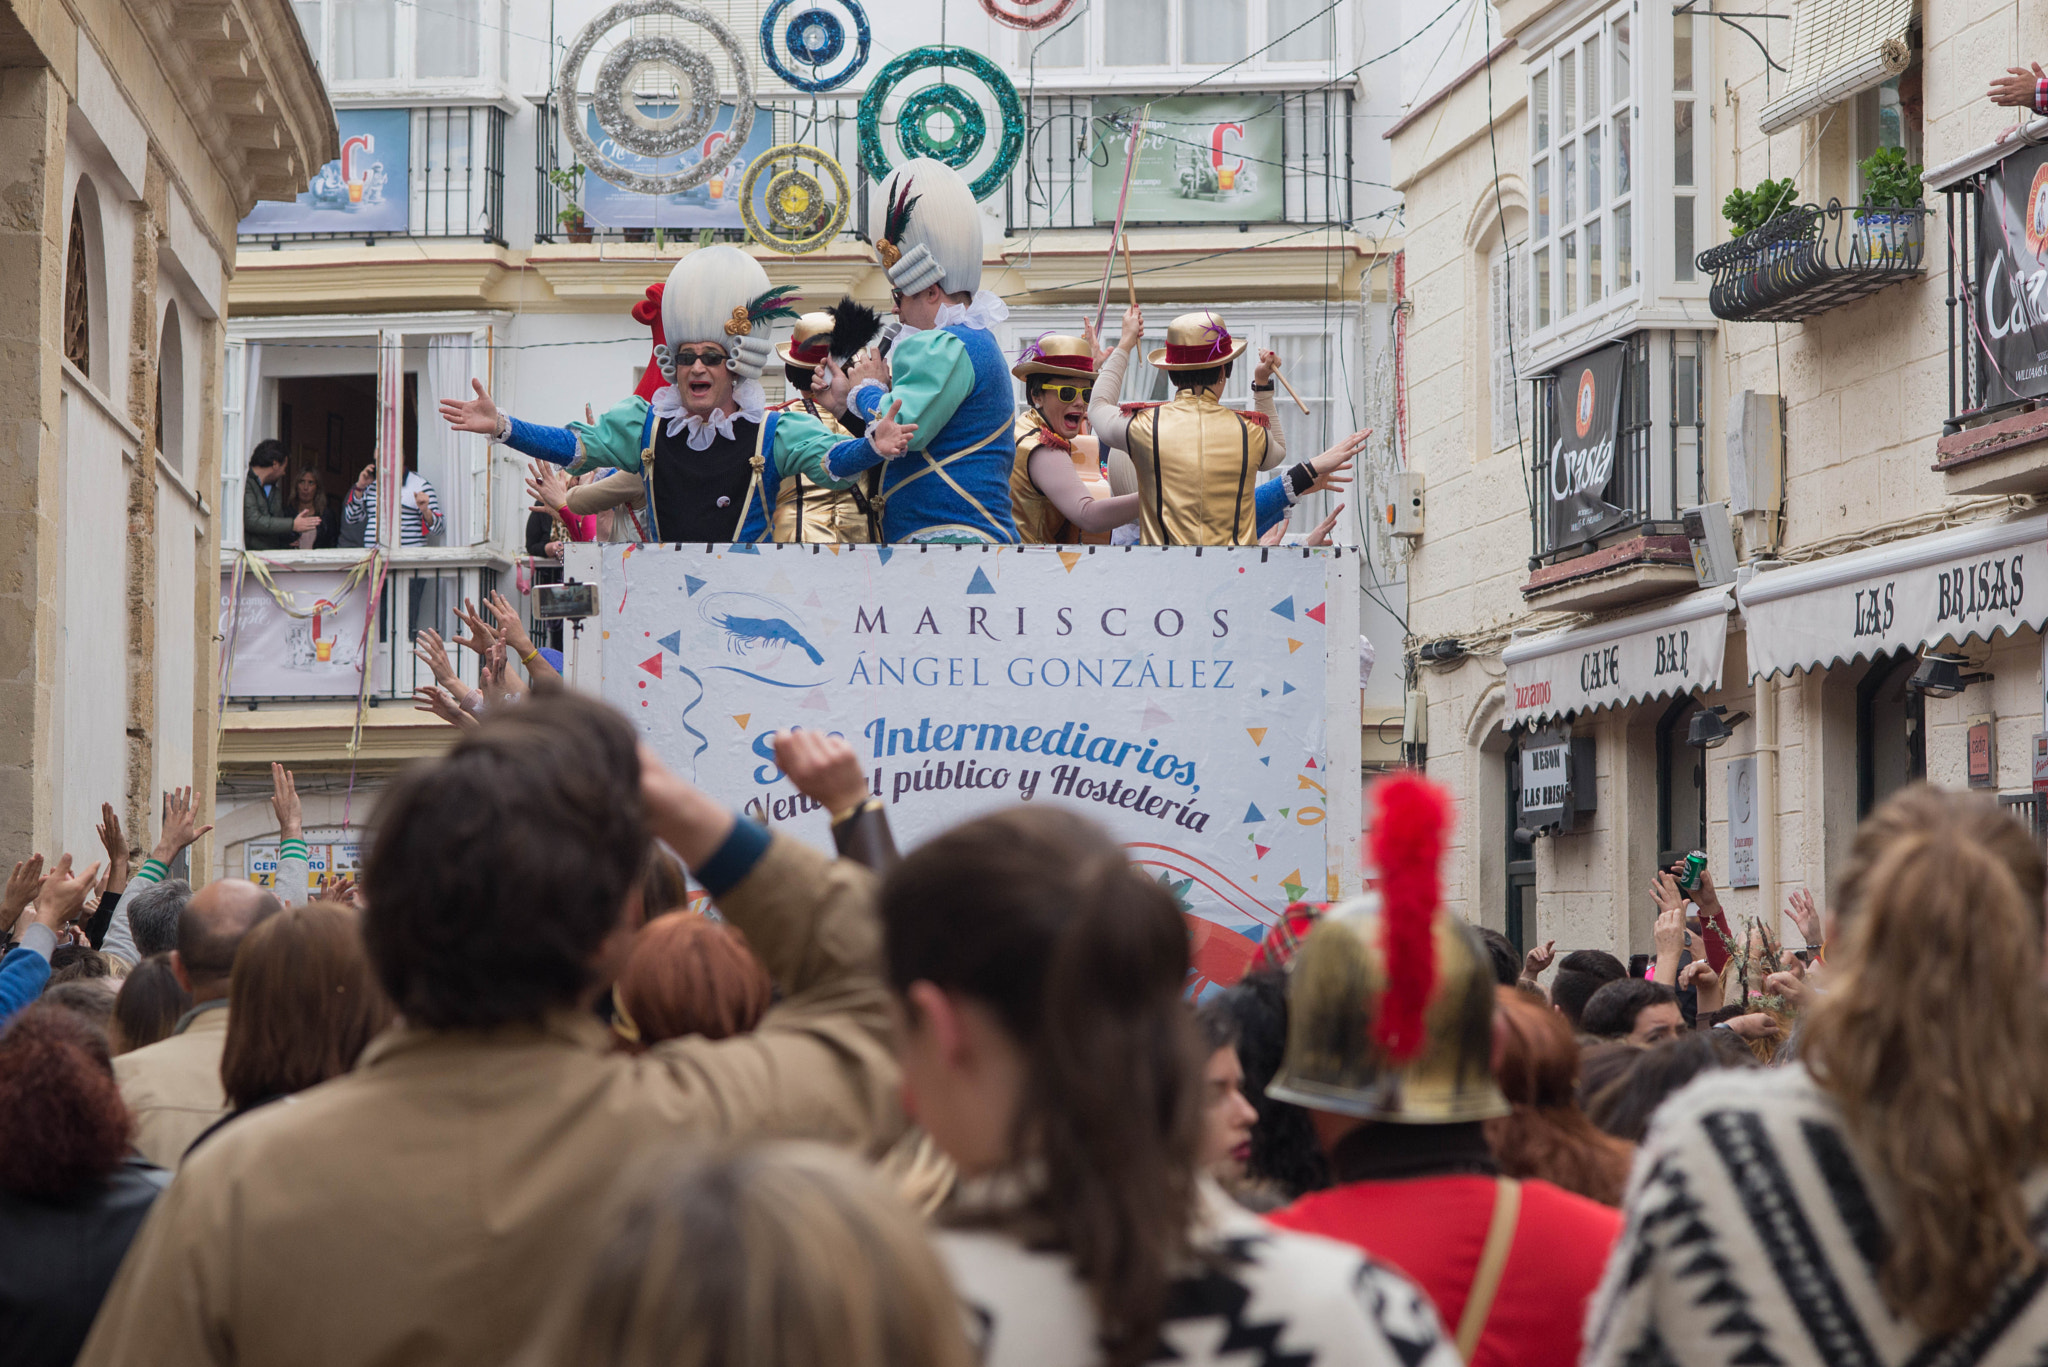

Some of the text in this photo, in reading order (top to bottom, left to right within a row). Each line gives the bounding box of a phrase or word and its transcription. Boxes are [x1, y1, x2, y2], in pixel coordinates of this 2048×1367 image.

[854, 604, 1230, 641] MARISCOS
[1854, 554, 2024, 640] LAS BRISAS
[848, 650, 1235, 689] ÁNGEL GONZÁLEZ
[1580, 630, 1689, 696] CAFE BAR
[864, 716, 1201, 795] Intermediarios,
[1532, 748, 1560, 771] MESON
[892, 759, 1011, 804] público
[1018, 769, 1041, 801] y
[1050, 764, 1210, 833] Hostelería
[1524, 787, 1540, 807] LAS
